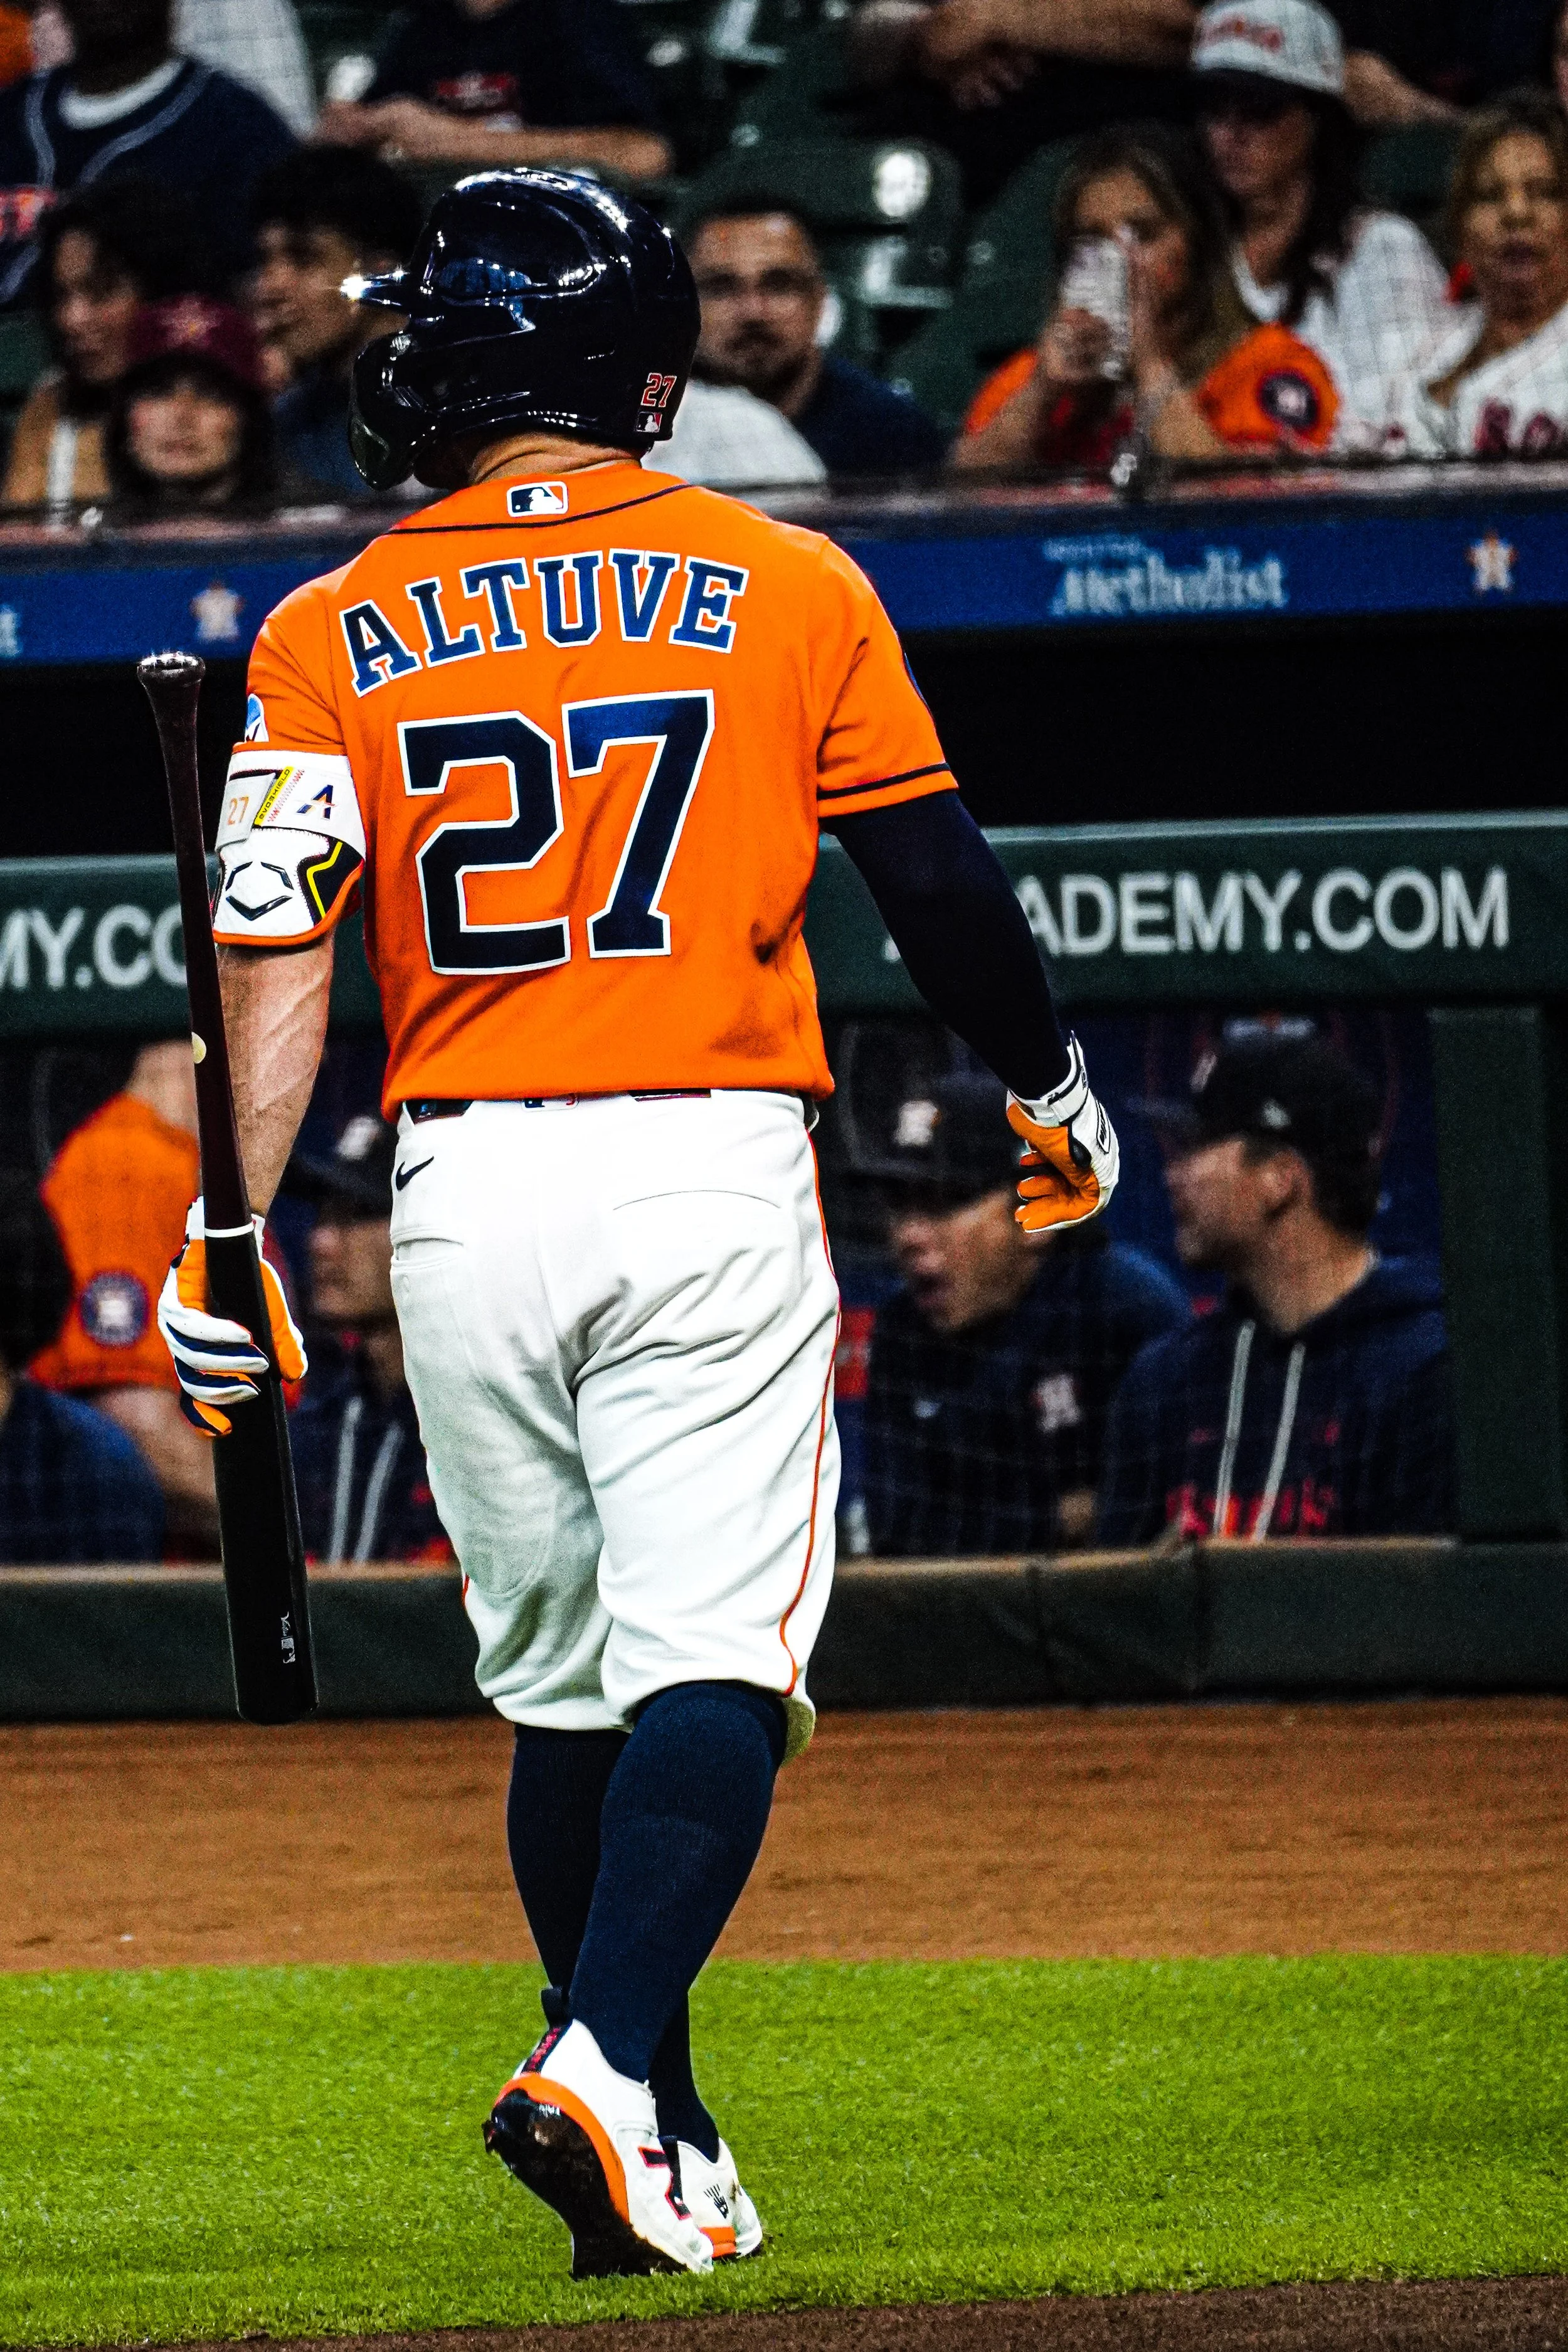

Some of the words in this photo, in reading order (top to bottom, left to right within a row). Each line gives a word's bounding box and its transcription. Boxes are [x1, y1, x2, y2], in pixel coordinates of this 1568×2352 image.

[641, 373, 677, 408] 27
[339, 548, 750, 697] ALTUVE
[227, 796, 249, 825] 27
[396, 689, 715, 975] 27
[884, 868, 1508, 961] ADEMY.COM
